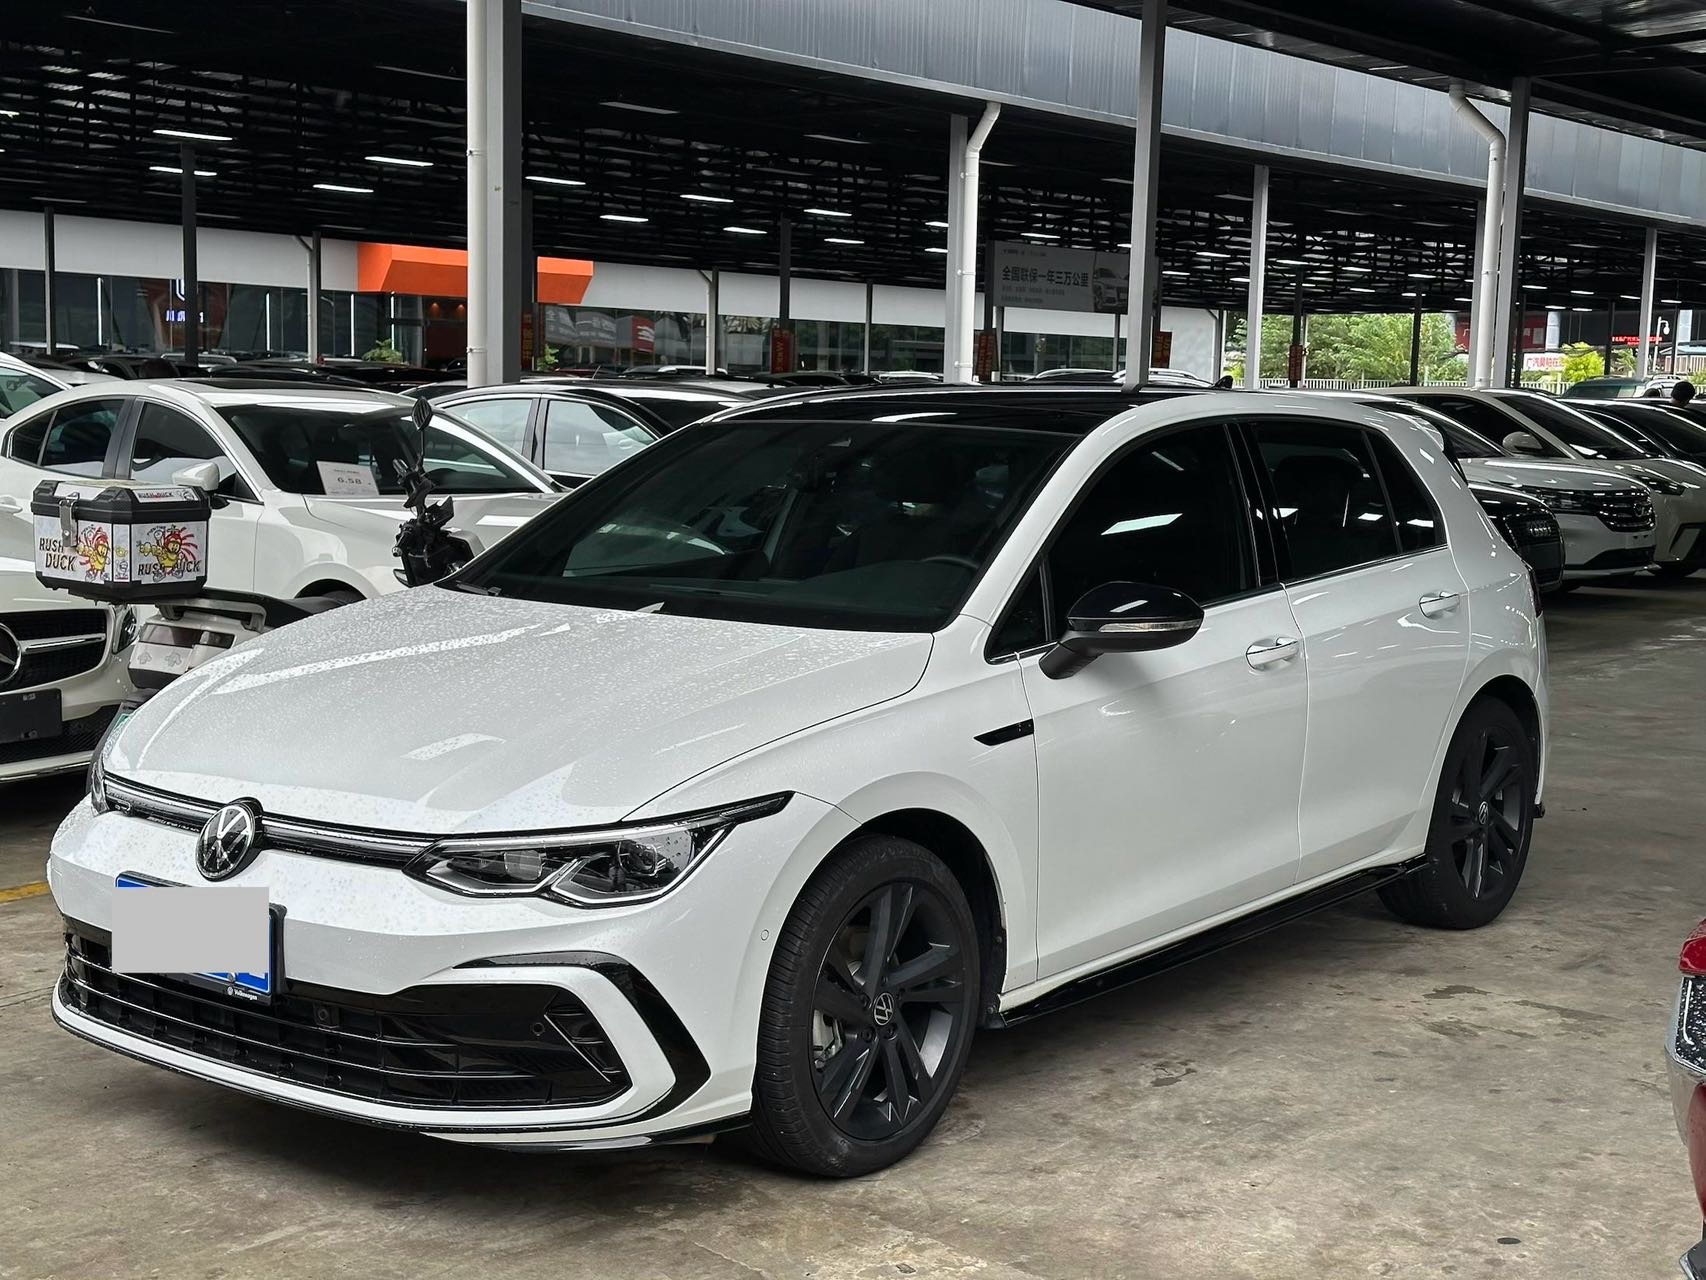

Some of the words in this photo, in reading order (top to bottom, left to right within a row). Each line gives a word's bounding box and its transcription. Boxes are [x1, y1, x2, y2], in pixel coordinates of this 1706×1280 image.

[1002, 265, 1088, 287] 全国联保一年三万公里
[39, 537, 64, 553] RUSH
[46, 552, 76, 571] DUCK
